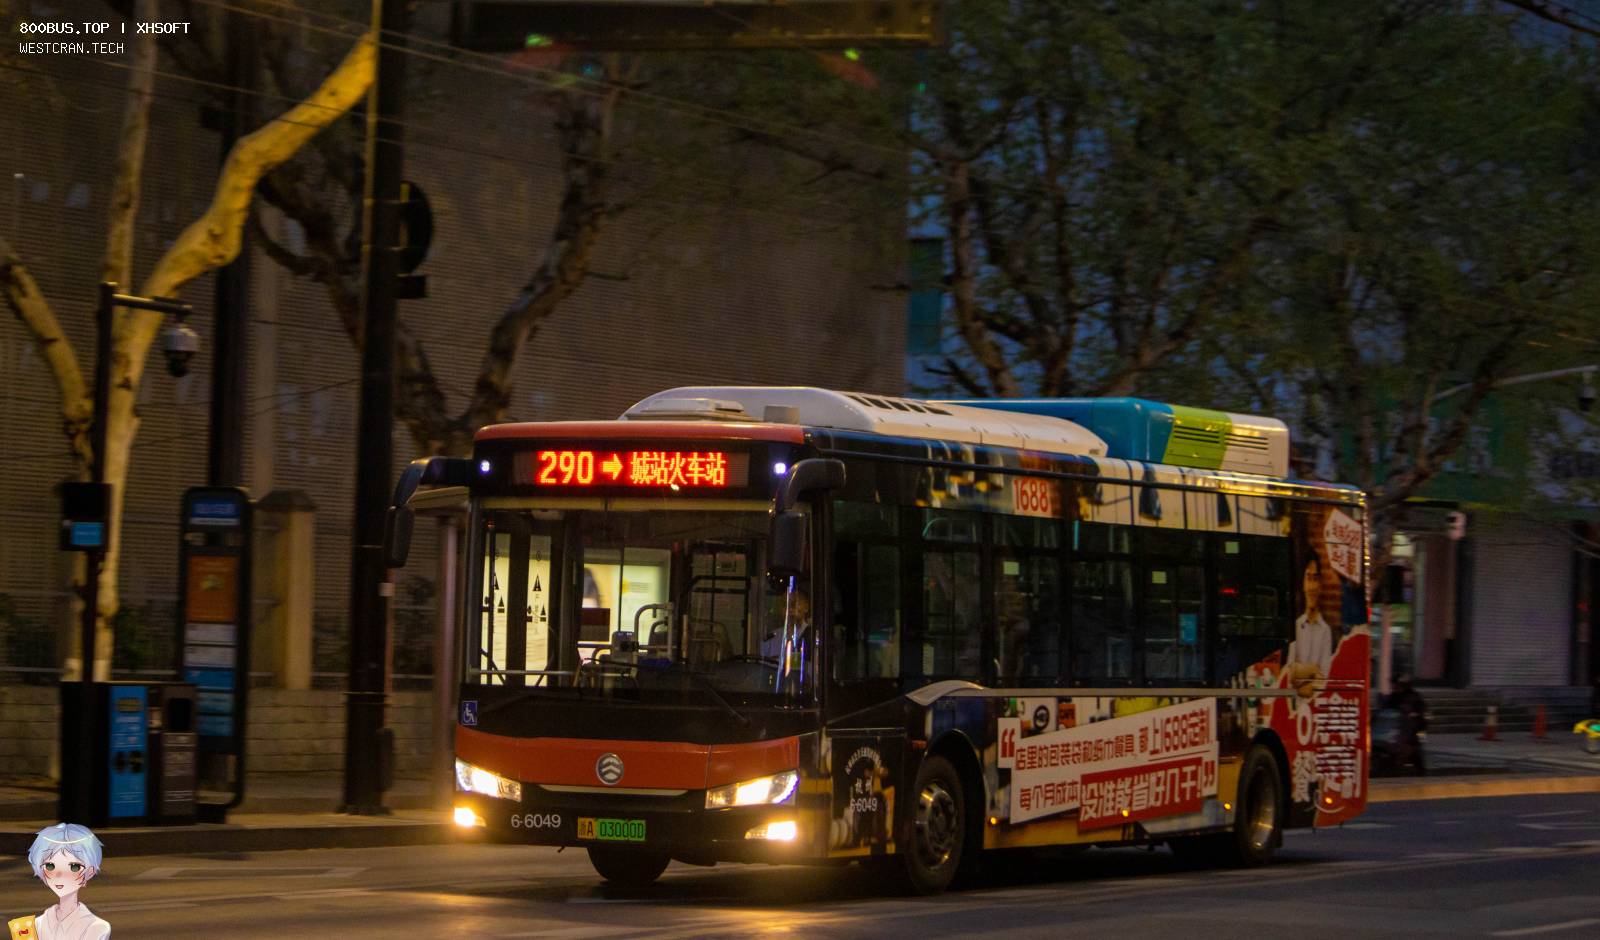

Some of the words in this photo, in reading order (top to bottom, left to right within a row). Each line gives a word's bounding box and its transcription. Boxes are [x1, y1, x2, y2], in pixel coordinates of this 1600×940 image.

[539, 450, 594, 485] 290
[630, 451, 726, 486] 城站火车站
[1013, 479, 1050, 512] 1688
[850, 797, 878, 812] 6-6049
[510, 813, 562, 829] 6-6049
